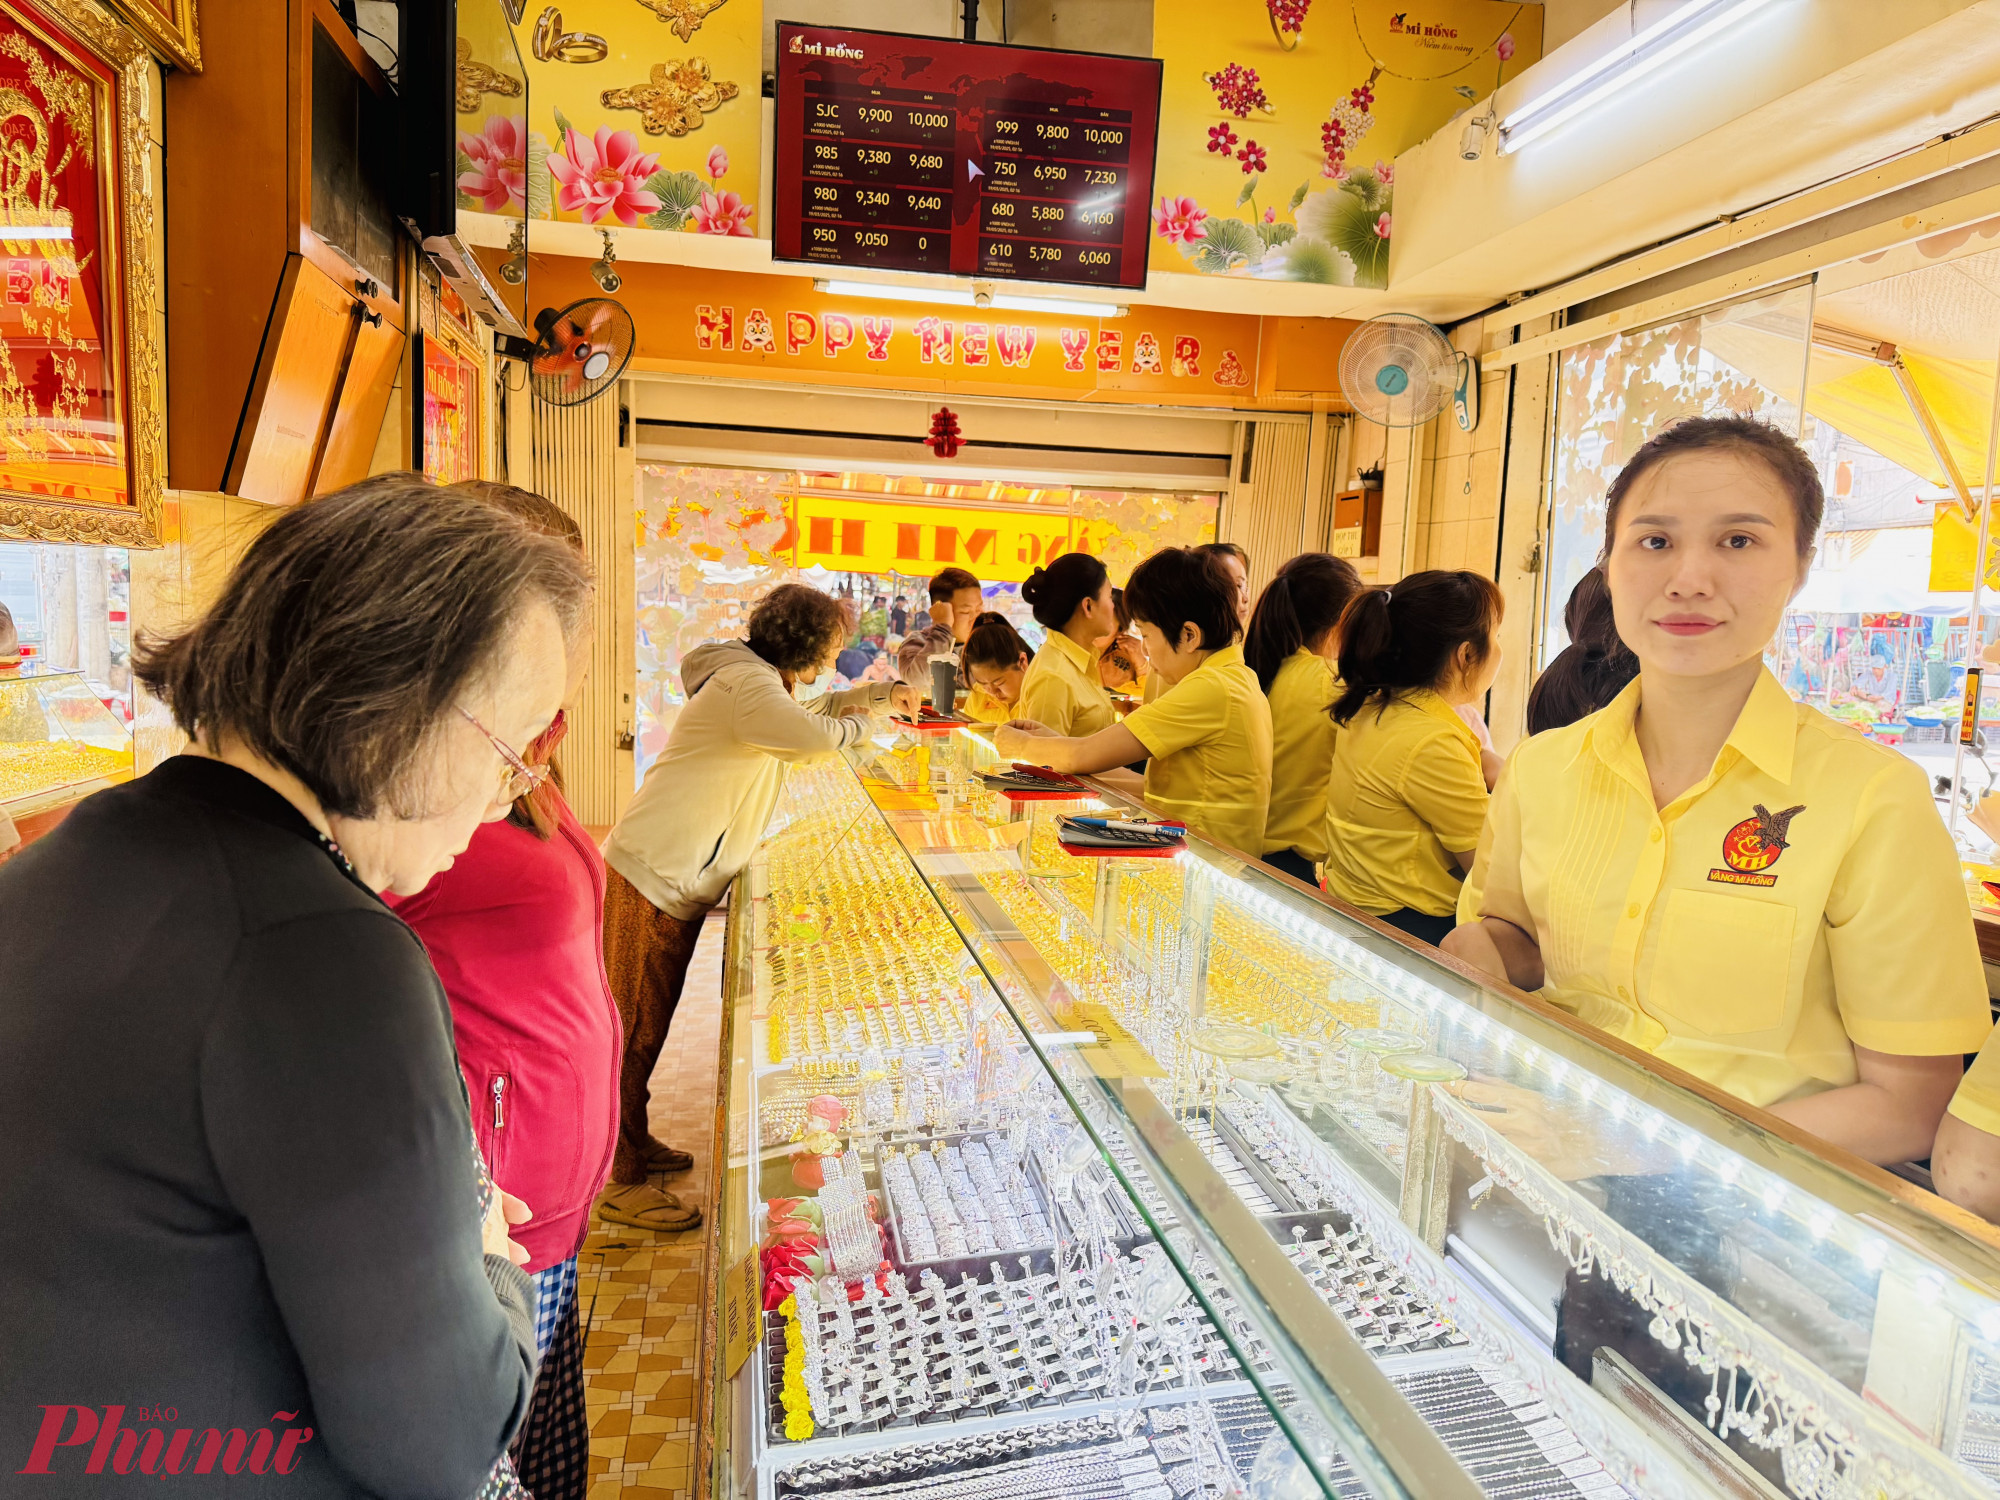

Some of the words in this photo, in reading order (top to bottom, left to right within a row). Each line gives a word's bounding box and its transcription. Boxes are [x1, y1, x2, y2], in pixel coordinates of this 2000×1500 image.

[1424, 22, 1458, 38] HỒNG
[825, 42, 864, 60] HỒNG
[816, 104, 839, 117] SJC
[858, 107, 893, 123] 9,900
[908, 112, 948, 128] 10,000
[996, 121, 1018, 134] 999
[1036, 124, 1069, 139] 9,800
[1084, 129, 1123, 144] 10,000
[815, 146, 838, 159] 985
[857, 150, 891, 164] 9,380
[909, 154, 942, 169] 9,680
[994, 162, 1016, 175] 750
[1034, 166, 1067, 180] 6,950
[1084, 170, 1116, 185] 7,230
[814, 187, 837, 200] 980
[856, 191, 890, 205] 9,340
[908, 195, 941, 210] 9,640
[992, 203, 1014, 216] 680
[1032, 207, 1064, 221] 5,880
[1081, 211, 1113, 225] 6,160
[813, 228, 836, 241] 950
[855, 232, 888, 247] 9,050
[919, 238, 927, 249] 0
[990, 244, 1012, 257] 610
[1030, 247, 1062, 261] 5,780
[1079, 251, 1111, 265] 6,060
[695, 304, 893, 360] HAPPY
[913, 315, 1037, 368] NEW
[1060, 327, 1201, 378] YEAR
[1727, 850, 1770, 870] MH
[1710, 870, 1734, 882] VÀNG
